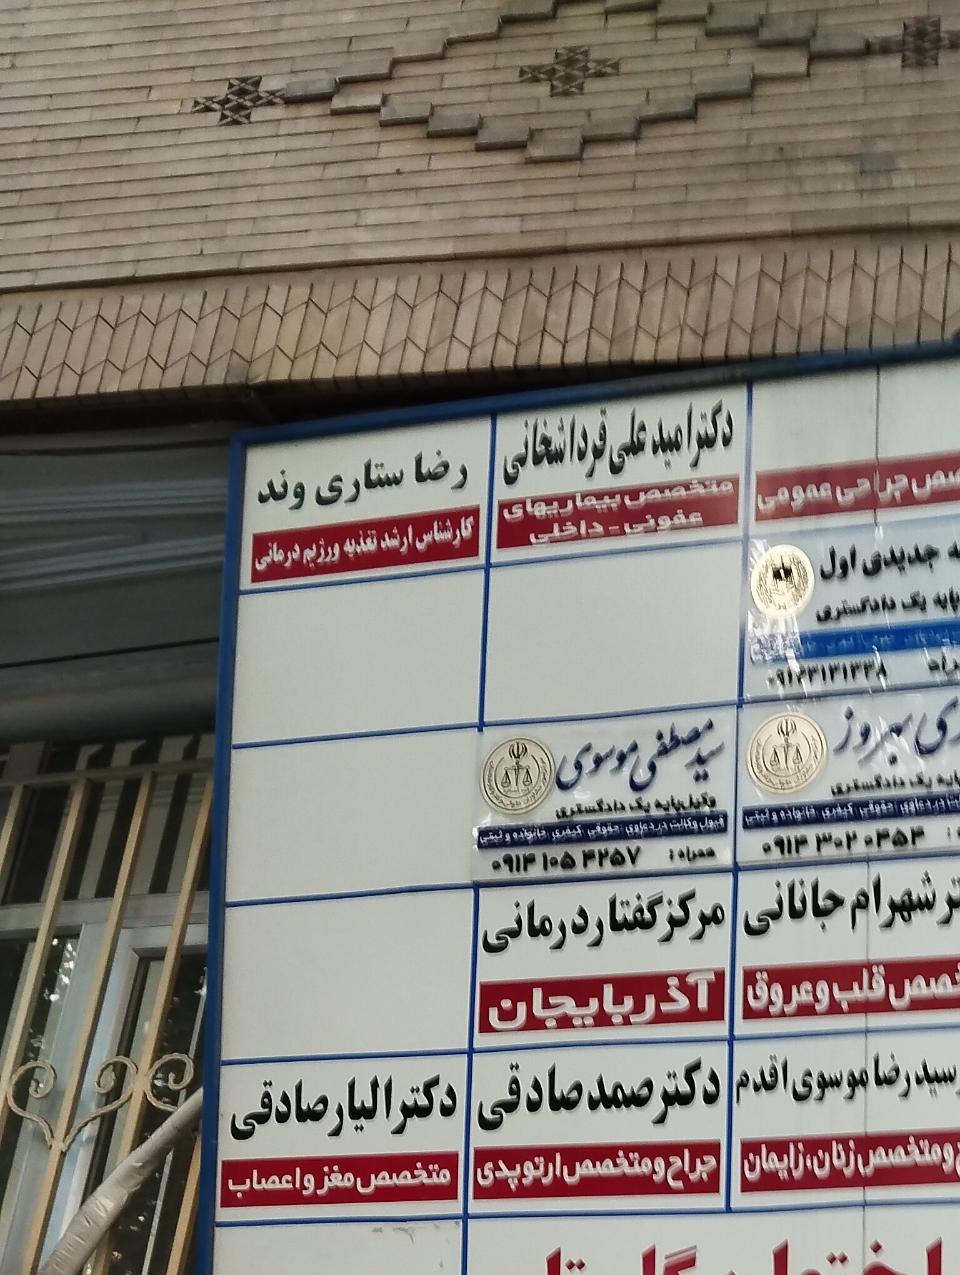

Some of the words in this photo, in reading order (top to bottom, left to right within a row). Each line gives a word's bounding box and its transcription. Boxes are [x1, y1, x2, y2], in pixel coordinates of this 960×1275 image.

[689, 399, 733, 468] دکتر
[257, 469, 306, 510] وند
[315, 458, 403, 506] ستاری
[414, 449, 468, 490] رضا
[836, 473, 909, 506] جراحی
[503, 493, 621, 522] بیماریهای
[624, 478, 734, 507] متخصص
[757, 482, 833, 512] عمومی
[380, 524, 413, 552] ارشد
[415, 515, 474, 550] کارشناس
[530, 518, 604, 545] داخلی
[623, 509, 703, 534] عفونی
[255, 542, 300, 571] درمانی
[344, 529, 377, 559] تغذیه
[820, 545, 857, 580] اول
[862, 544, 939, 577] جدیدی
[555, 739, 639, 791] موسوی
[629, 718, 714, 792] مصطفی
[586, 890, 664, 947] گفتار
[657, 887, 725, 943] مرکز
[743, 875, 846, 936] جانانی
[851, 870, 937, 932] شهرام
[482, 898, 590, 953] درمانی
[488, 970, 716, 1031] آذربایجان
[747, 970, 814, 1017] عروق
[833, 963, 885, 1014] قلب
[587, 1072, 654, 1110] صمد
[652, 1056, 721, 1124] دکتر
[735, 1053, 788, 1104] اقدم
[792, 1064, 869, 1101] موسوی
[873, 1051, 911, 1097] رضا
[915, 1057, 956, 1097] سید
[230, 1078, 329, 1140] صادقی
[327, 1074, 392, 1136] الیار
[391, 1073, 457, 1135] دکتر
[477, 1061, 583, 1130] صادقی
[227, 1166, 300, 1198] اعصاب
[316, 1164, 354, 1195] مغز
[356, 1161, 451, 1193] متخصص
[476, 1152, 561, 1192] ارتوپدی
[667, 1148, 717, 1192] جراح
[743, 1141, 804, 1182] زایمان
